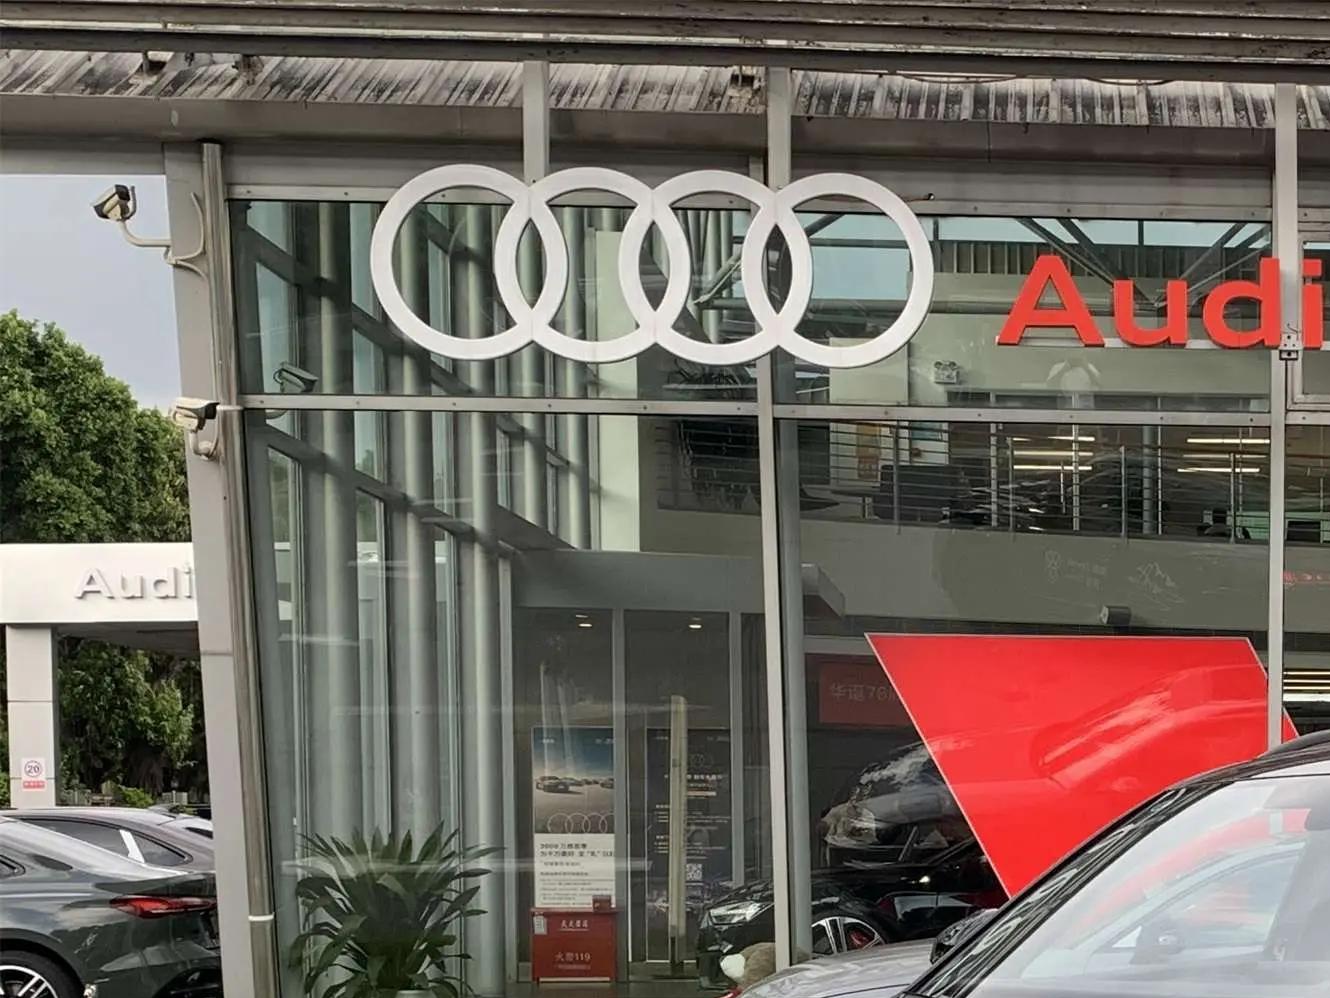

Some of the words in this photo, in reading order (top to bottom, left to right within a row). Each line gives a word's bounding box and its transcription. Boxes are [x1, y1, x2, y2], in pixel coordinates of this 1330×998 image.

[996, 253, 1324, 349] Audi
[74, 563, 193, 600] Audi
[27, 765, 40, 774] 20
